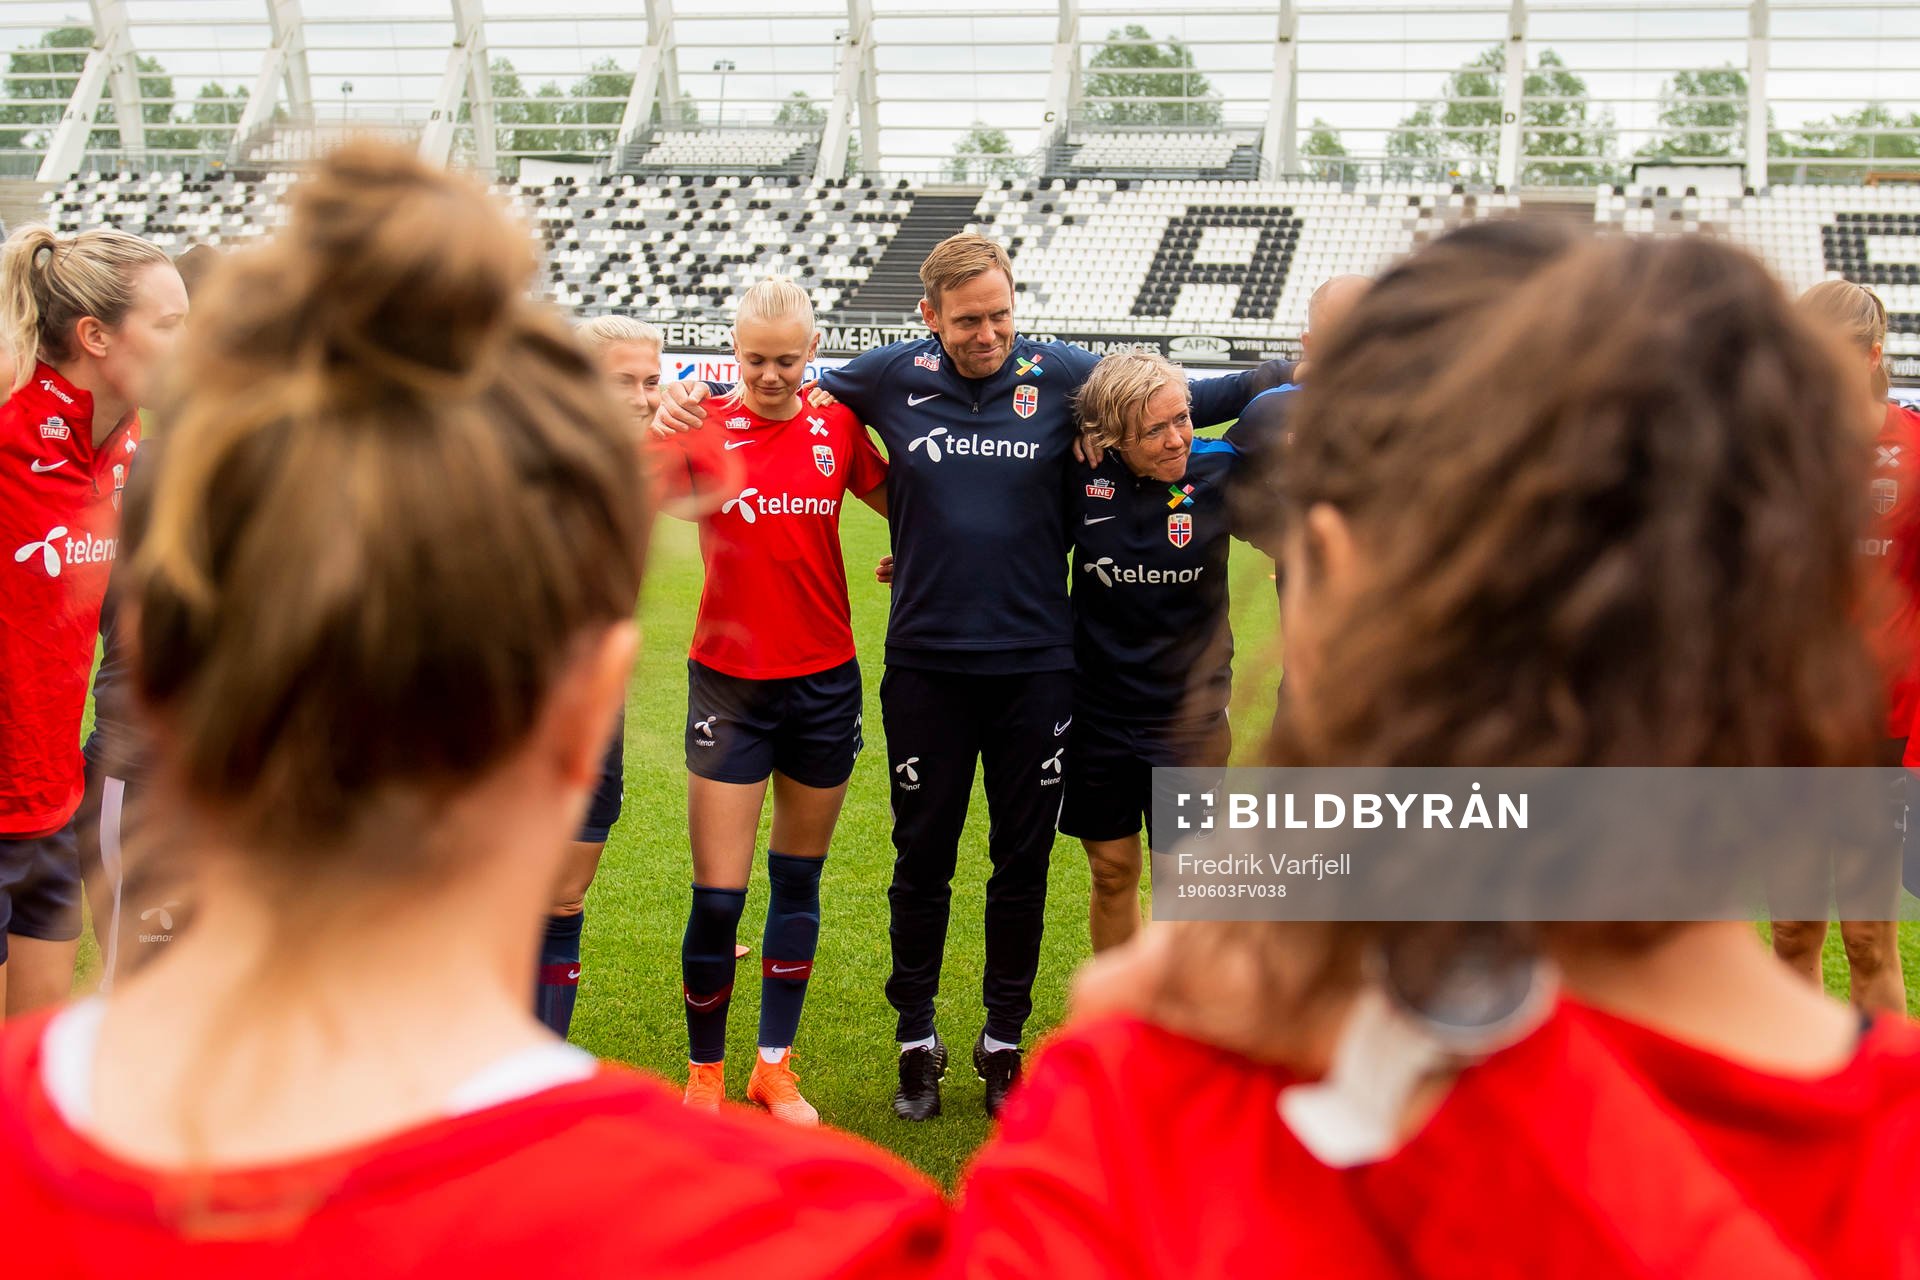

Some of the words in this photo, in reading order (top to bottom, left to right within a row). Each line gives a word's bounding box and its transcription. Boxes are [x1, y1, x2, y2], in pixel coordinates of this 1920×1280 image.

[1044, 111, 1055, 122] C
[1504, 112, 1516, 124] D
[1182, 339, 1220, 351] APN
[42, 427, 67, 437] TINE
[945, 433, 1040, 459] telenor
[1089, 486, 1111, 497] TINE
[757, 492, 836, 516] telenor
[65, 532, 119, 564] telen
[1112, 564, 1204, 584] telenor
